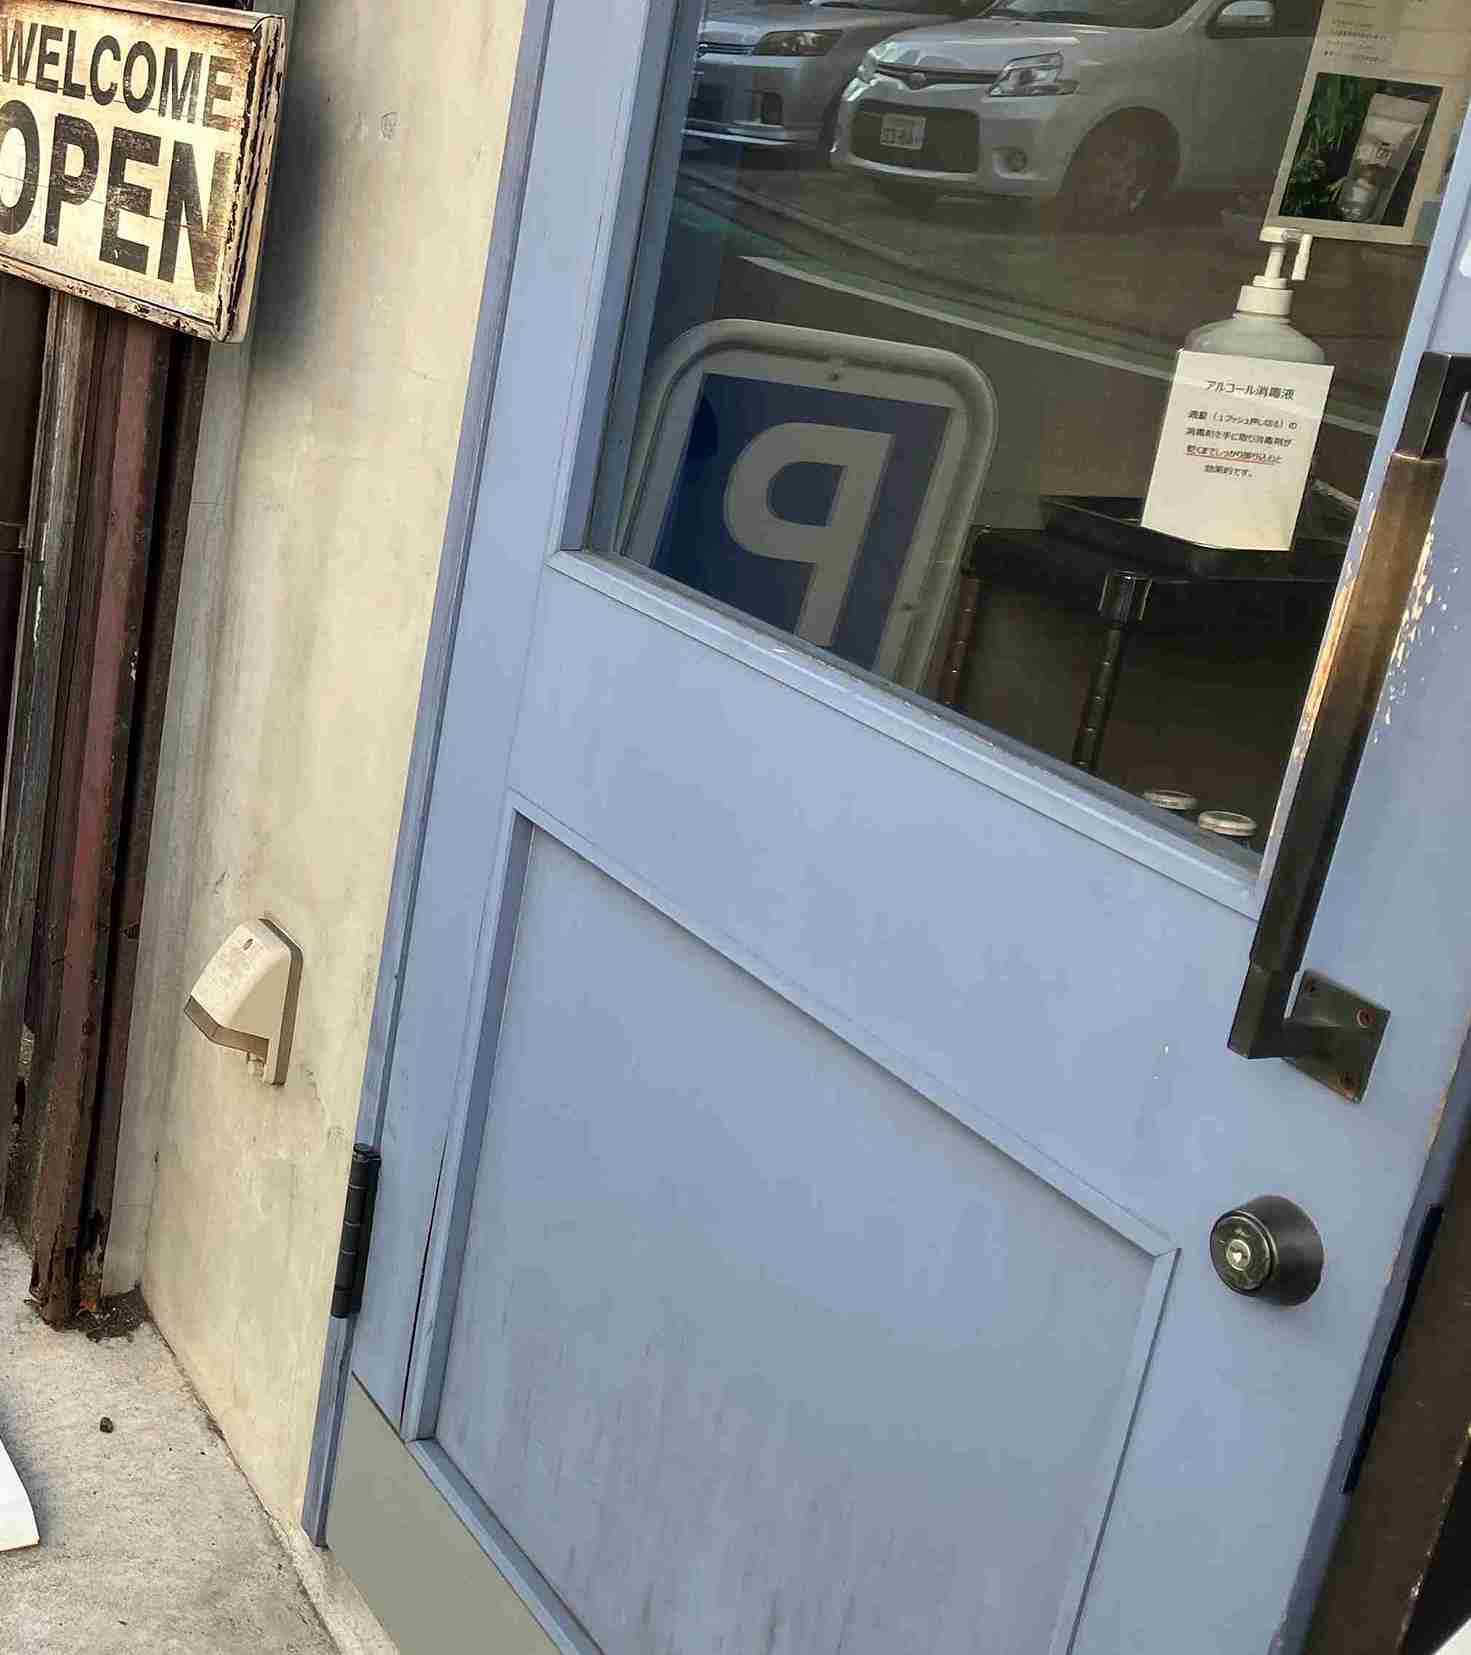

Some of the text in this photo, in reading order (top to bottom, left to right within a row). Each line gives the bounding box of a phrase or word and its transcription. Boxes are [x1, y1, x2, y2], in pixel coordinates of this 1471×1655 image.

[0, 20, 237, 132] WELCOME
[1206, 379, 1295, 401] アルコール消毒液
